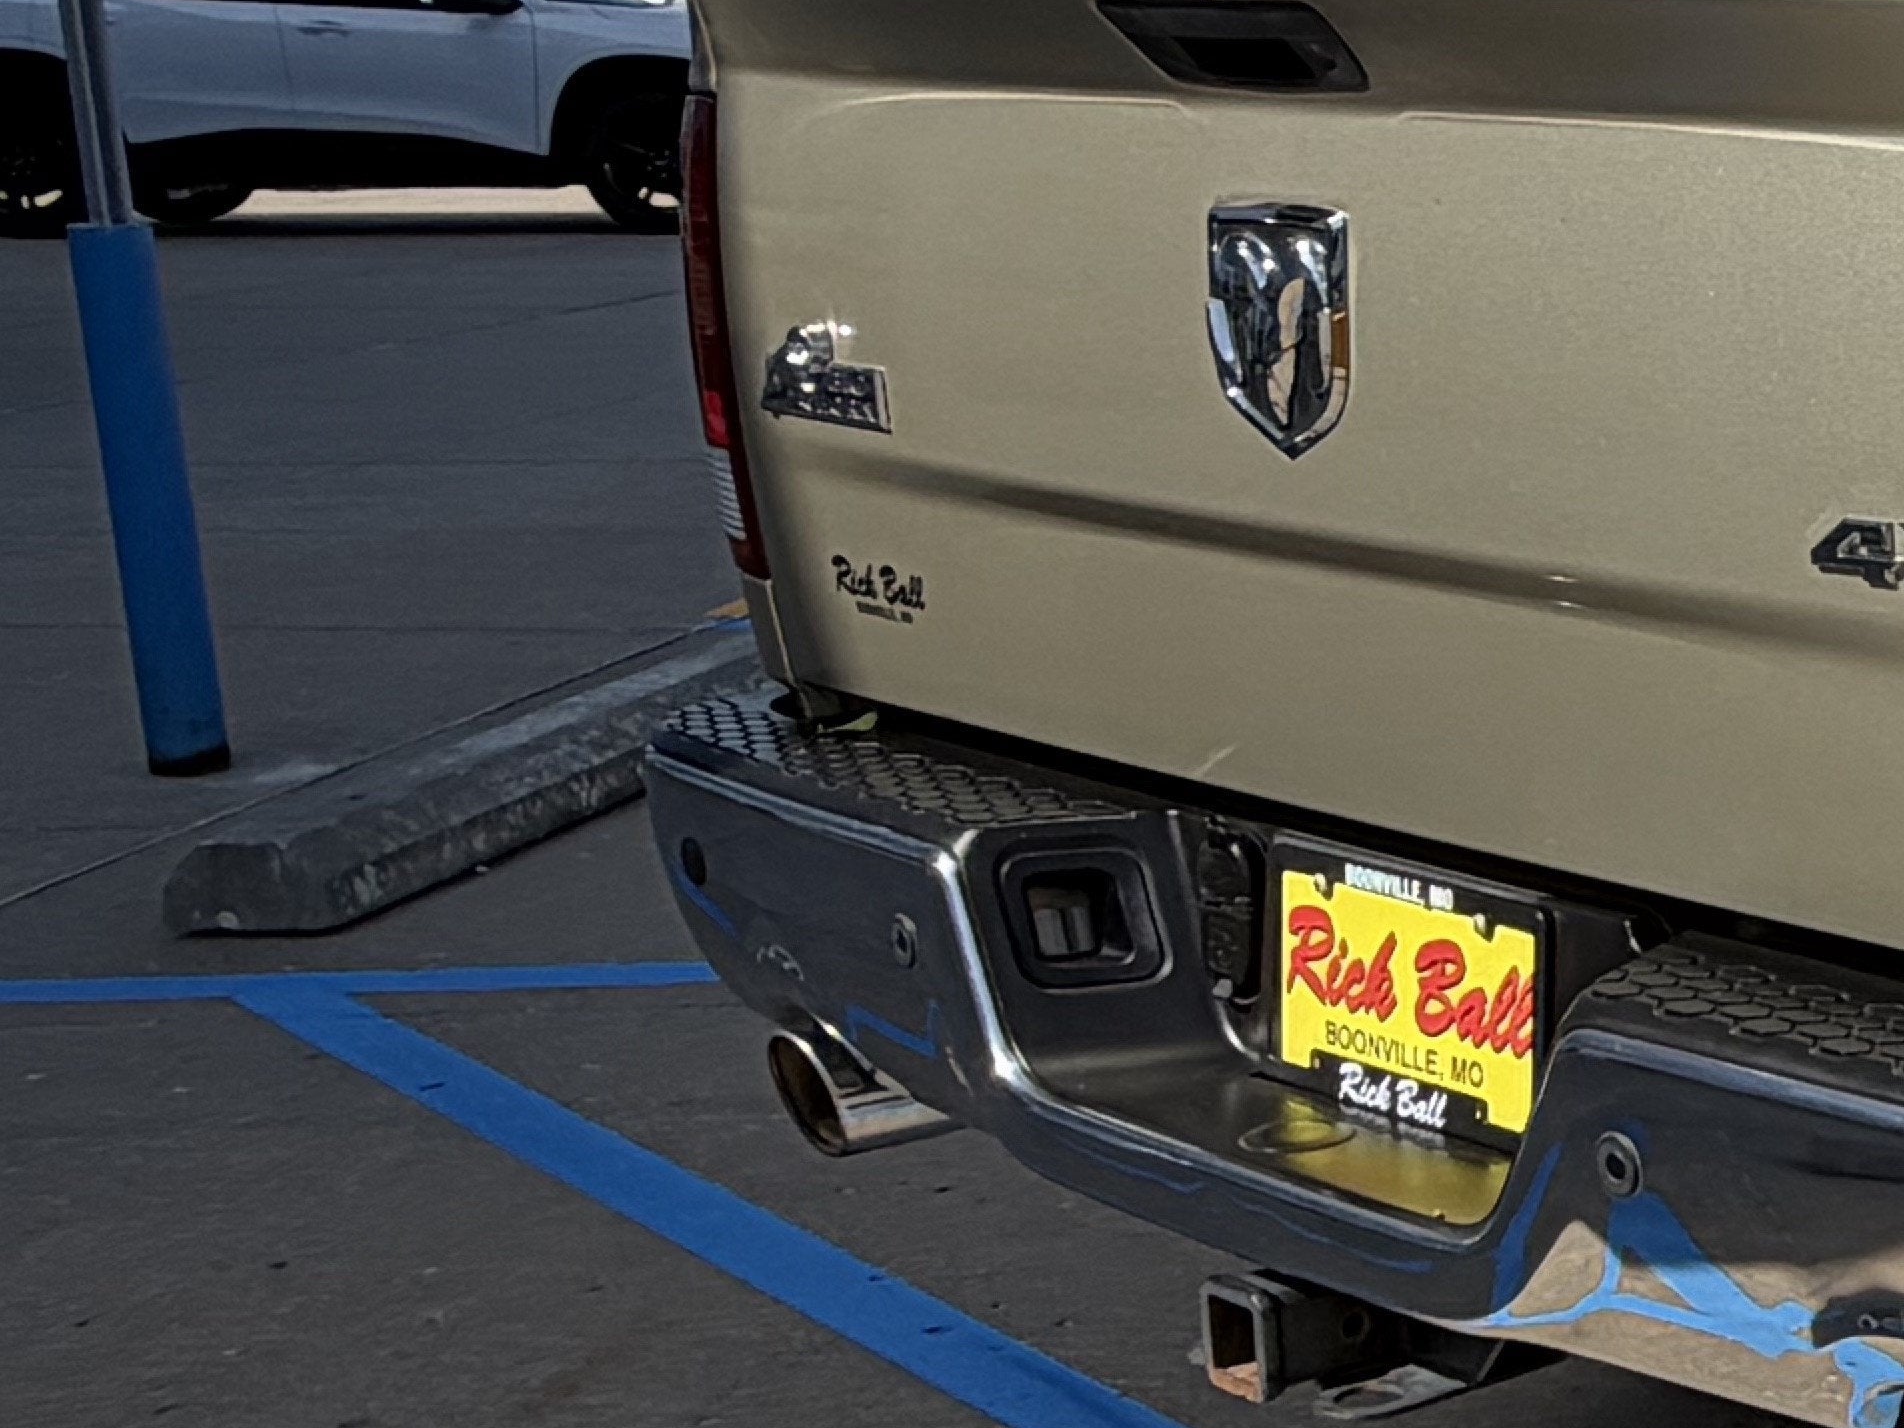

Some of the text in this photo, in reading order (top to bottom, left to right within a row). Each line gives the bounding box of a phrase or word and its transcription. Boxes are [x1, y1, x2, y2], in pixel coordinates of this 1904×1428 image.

[831, 554, 926, 610] Rick Ball
[1287, 904, 1533, 1059] Rick Ball
[1324, 1020, 1484, 1089] BOONVILLE, MO
[1338, 1061, 1449, 1129] Rick Ball
